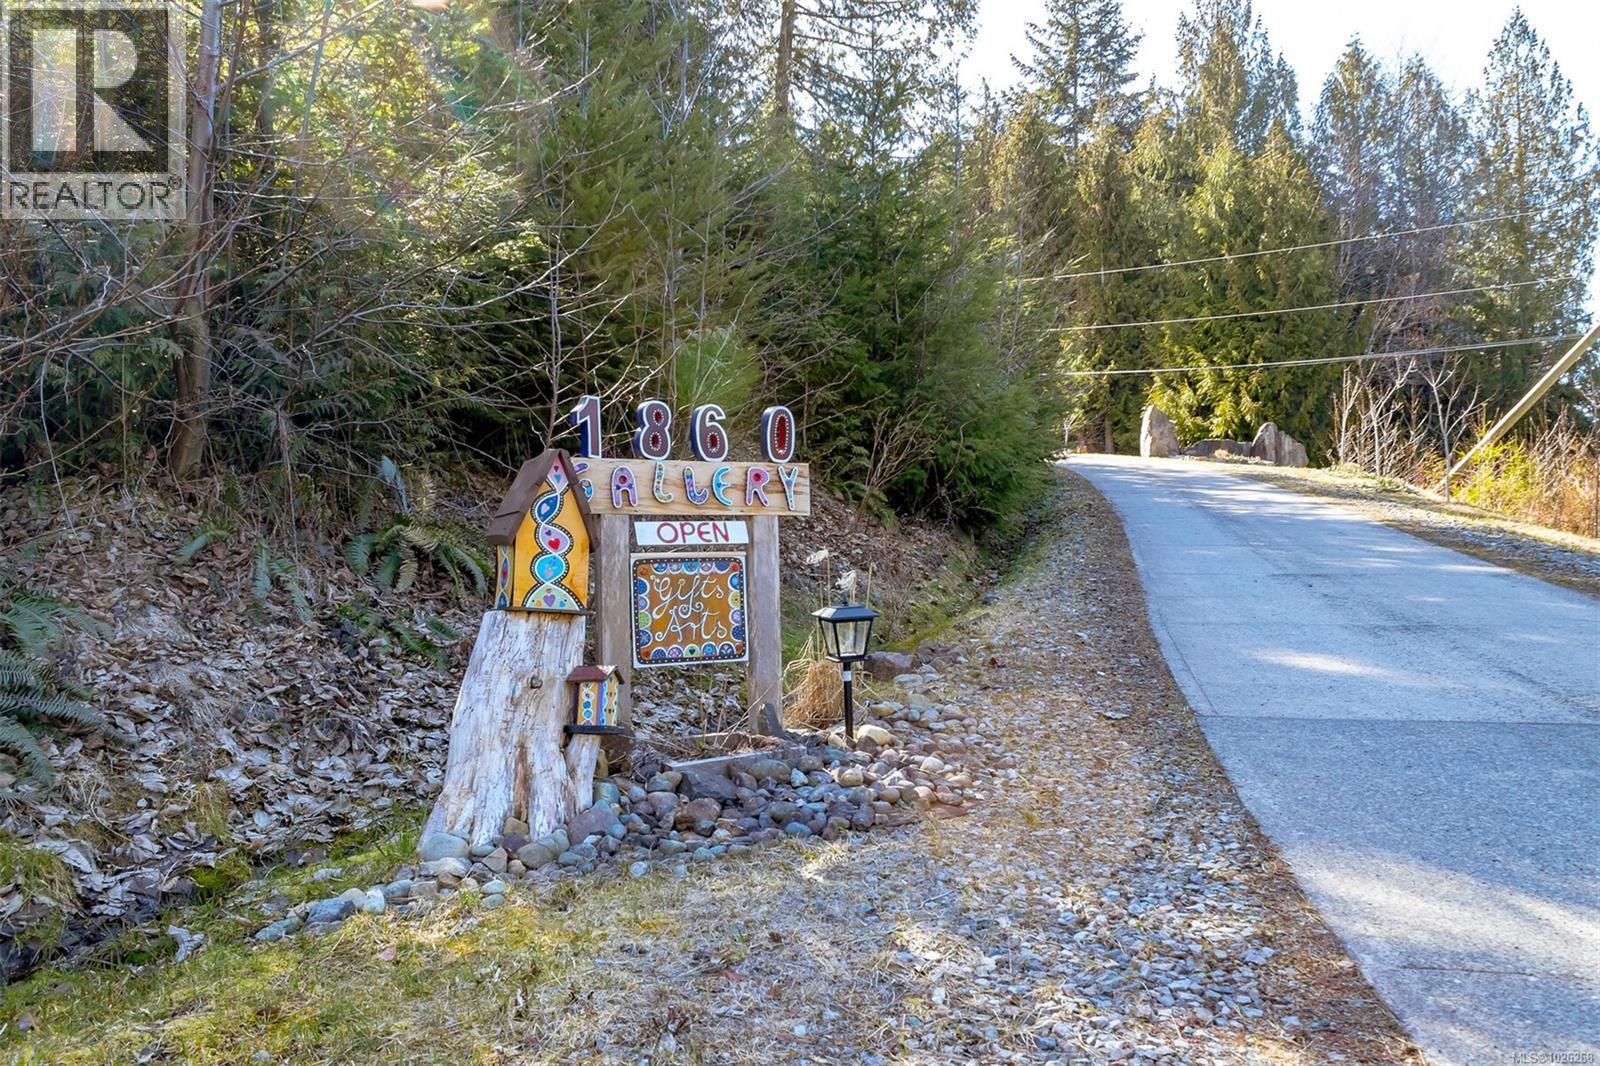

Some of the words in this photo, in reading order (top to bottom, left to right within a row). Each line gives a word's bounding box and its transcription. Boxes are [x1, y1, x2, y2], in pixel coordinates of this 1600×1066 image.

[570, 395, 796, 463] 1860
[656, 520, 730, 544] OPEN
[650, 575, 724, 619] Gifts
[655, 605, 727, 642] Arts
